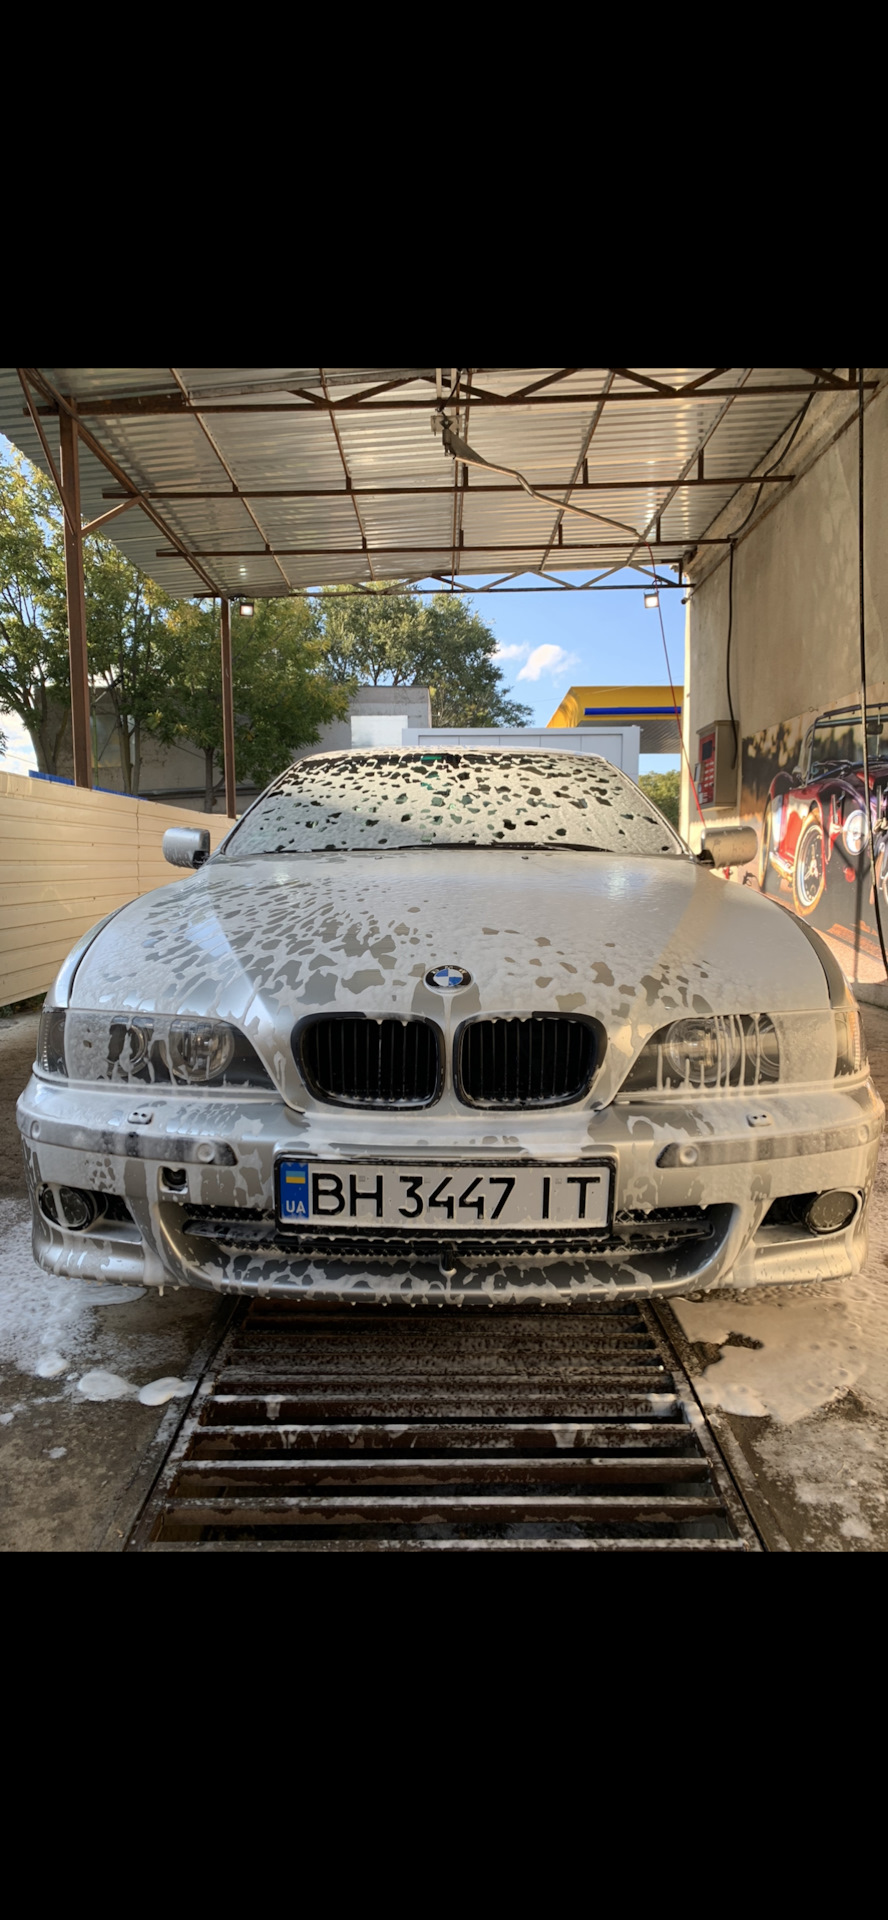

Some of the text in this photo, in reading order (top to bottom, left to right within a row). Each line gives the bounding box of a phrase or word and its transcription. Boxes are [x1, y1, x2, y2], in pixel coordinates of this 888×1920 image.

[286, 1200, 306, 1215] UA
[312, 1173, 383, 1217] BH
[398, 1176, 516, 1219] 3447
